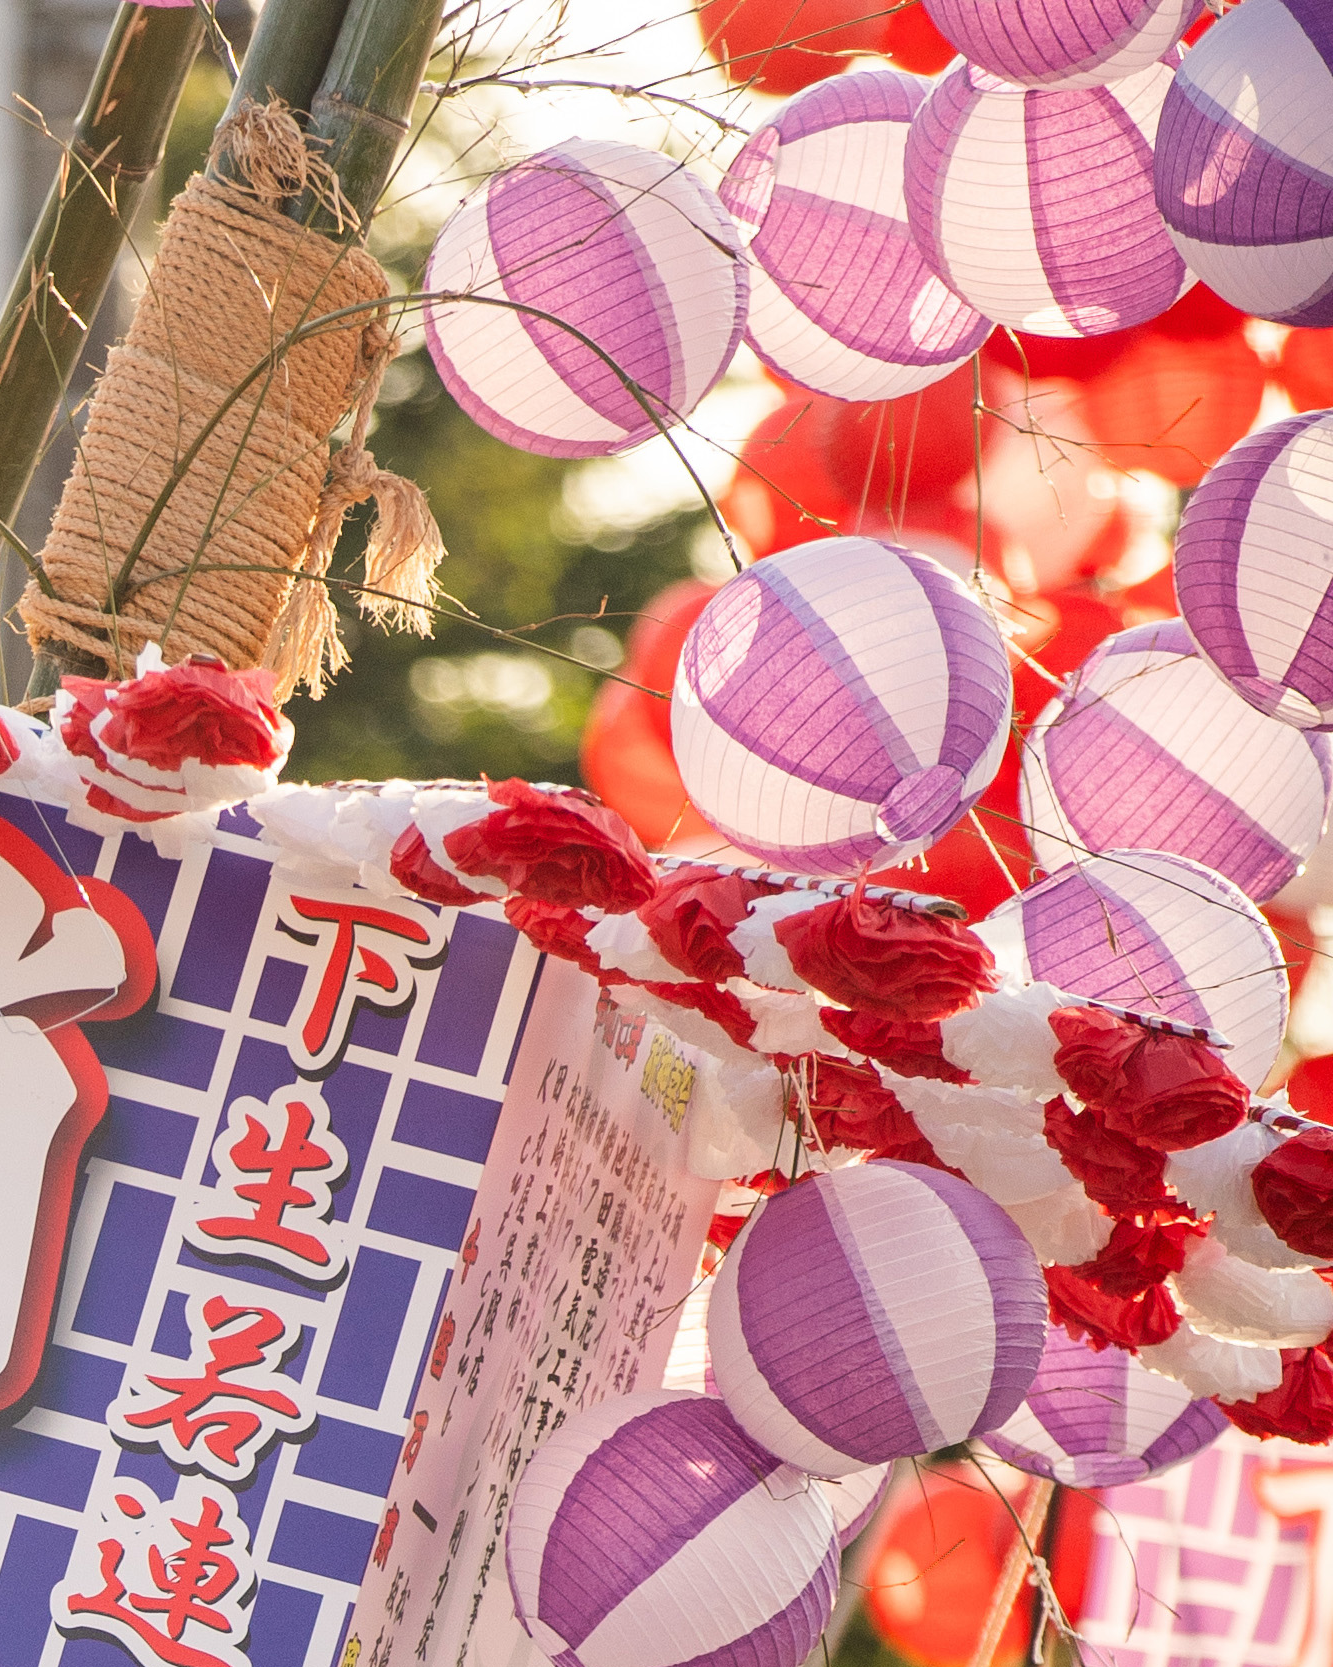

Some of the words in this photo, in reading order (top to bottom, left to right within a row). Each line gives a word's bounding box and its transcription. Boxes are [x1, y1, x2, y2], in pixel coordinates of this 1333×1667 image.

[464, 1064, 568, 1398] 田丸屋呉服店
[524, 1129, 630, 1465] 池田電気工事
